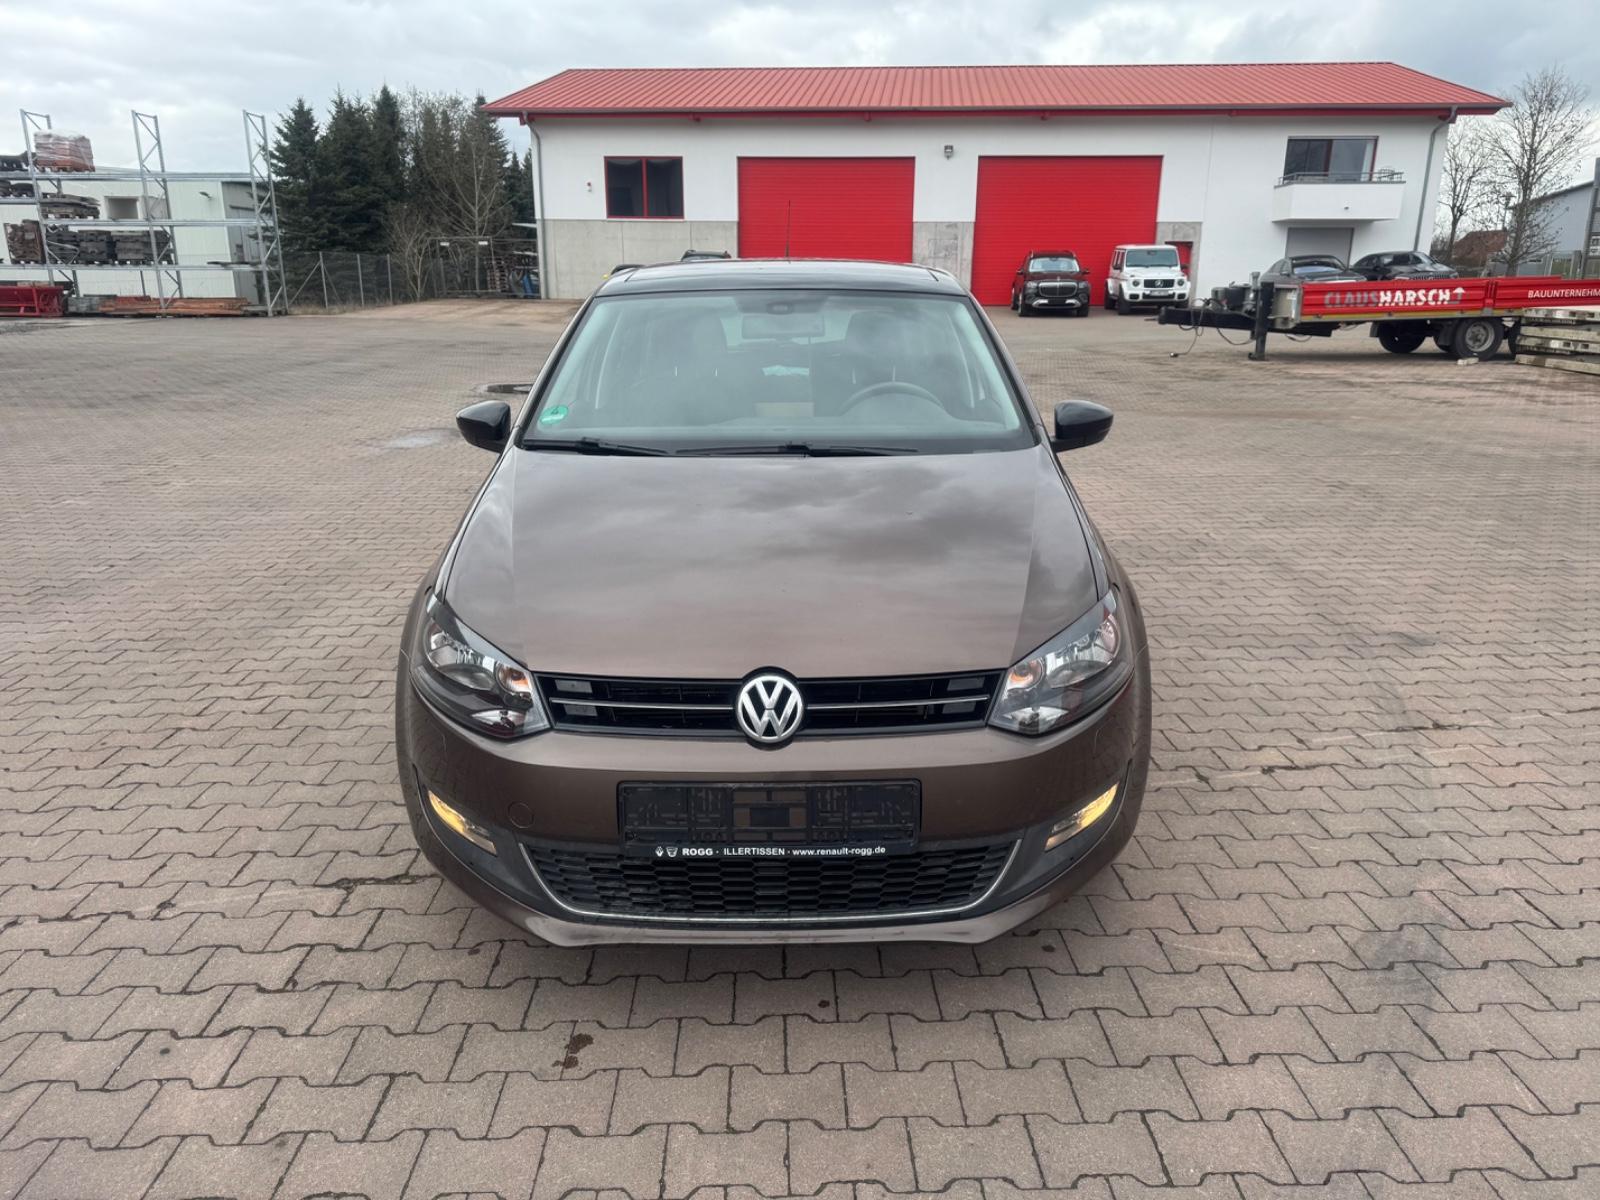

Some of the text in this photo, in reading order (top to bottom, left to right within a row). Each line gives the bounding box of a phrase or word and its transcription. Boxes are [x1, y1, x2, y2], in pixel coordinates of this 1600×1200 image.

[681, 846, 887, 857] ROGG ILLERTISSEN www.renault-rogg.de
